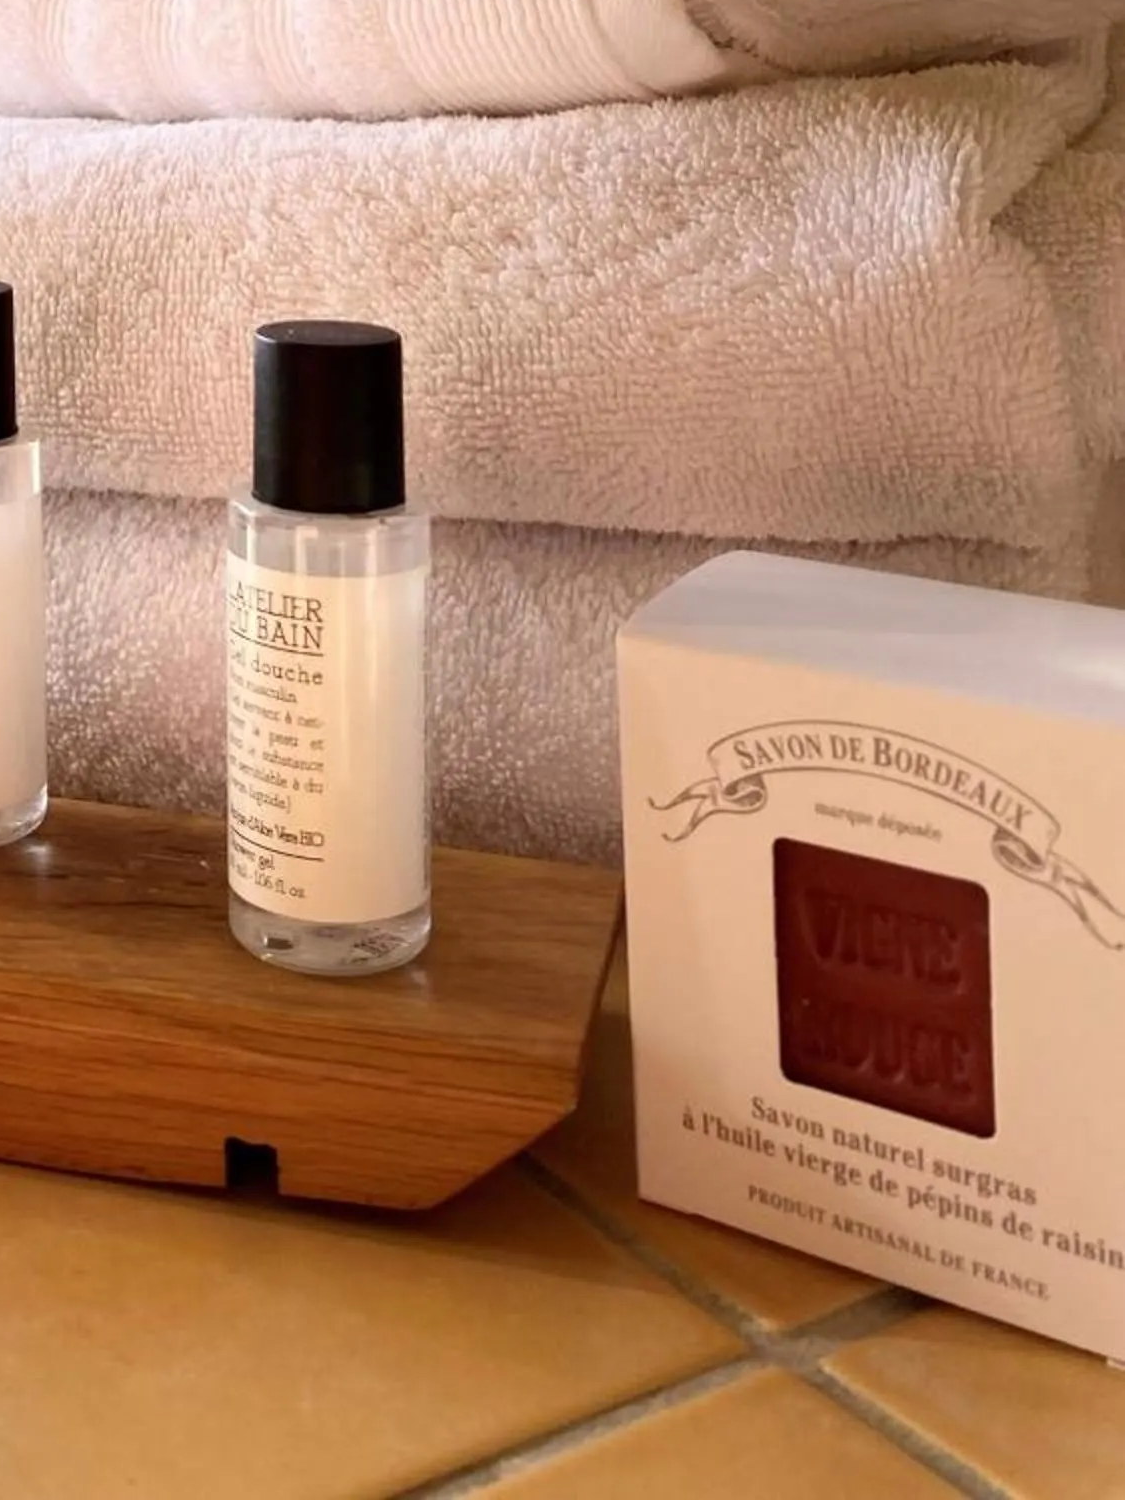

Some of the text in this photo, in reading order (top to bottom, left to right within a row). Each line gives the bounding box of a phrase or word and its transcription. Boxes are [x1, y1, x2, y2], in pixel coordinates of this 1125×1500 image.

[251, 652, 323, 685] douche
[257, 615, 324, 650] BAIN
[734, 734, 1033, 831] SAVON DE BORDEAUX
[682, 1105, 696, 1132] à
[702, 1112, 776, 1158] l'huile
[783, 1146, 862, 1188] vierge
[870, 1168, 899, 1197] de
[907, 1185, 993, 1229] pépins
[1001, 1210, 1034, 1241] de
[751, 1096, 1037, 1206] Savon naturel surgras
[748, 1184, 1051, 1301] PRODUIT ARTISANAL DE FRANCE
